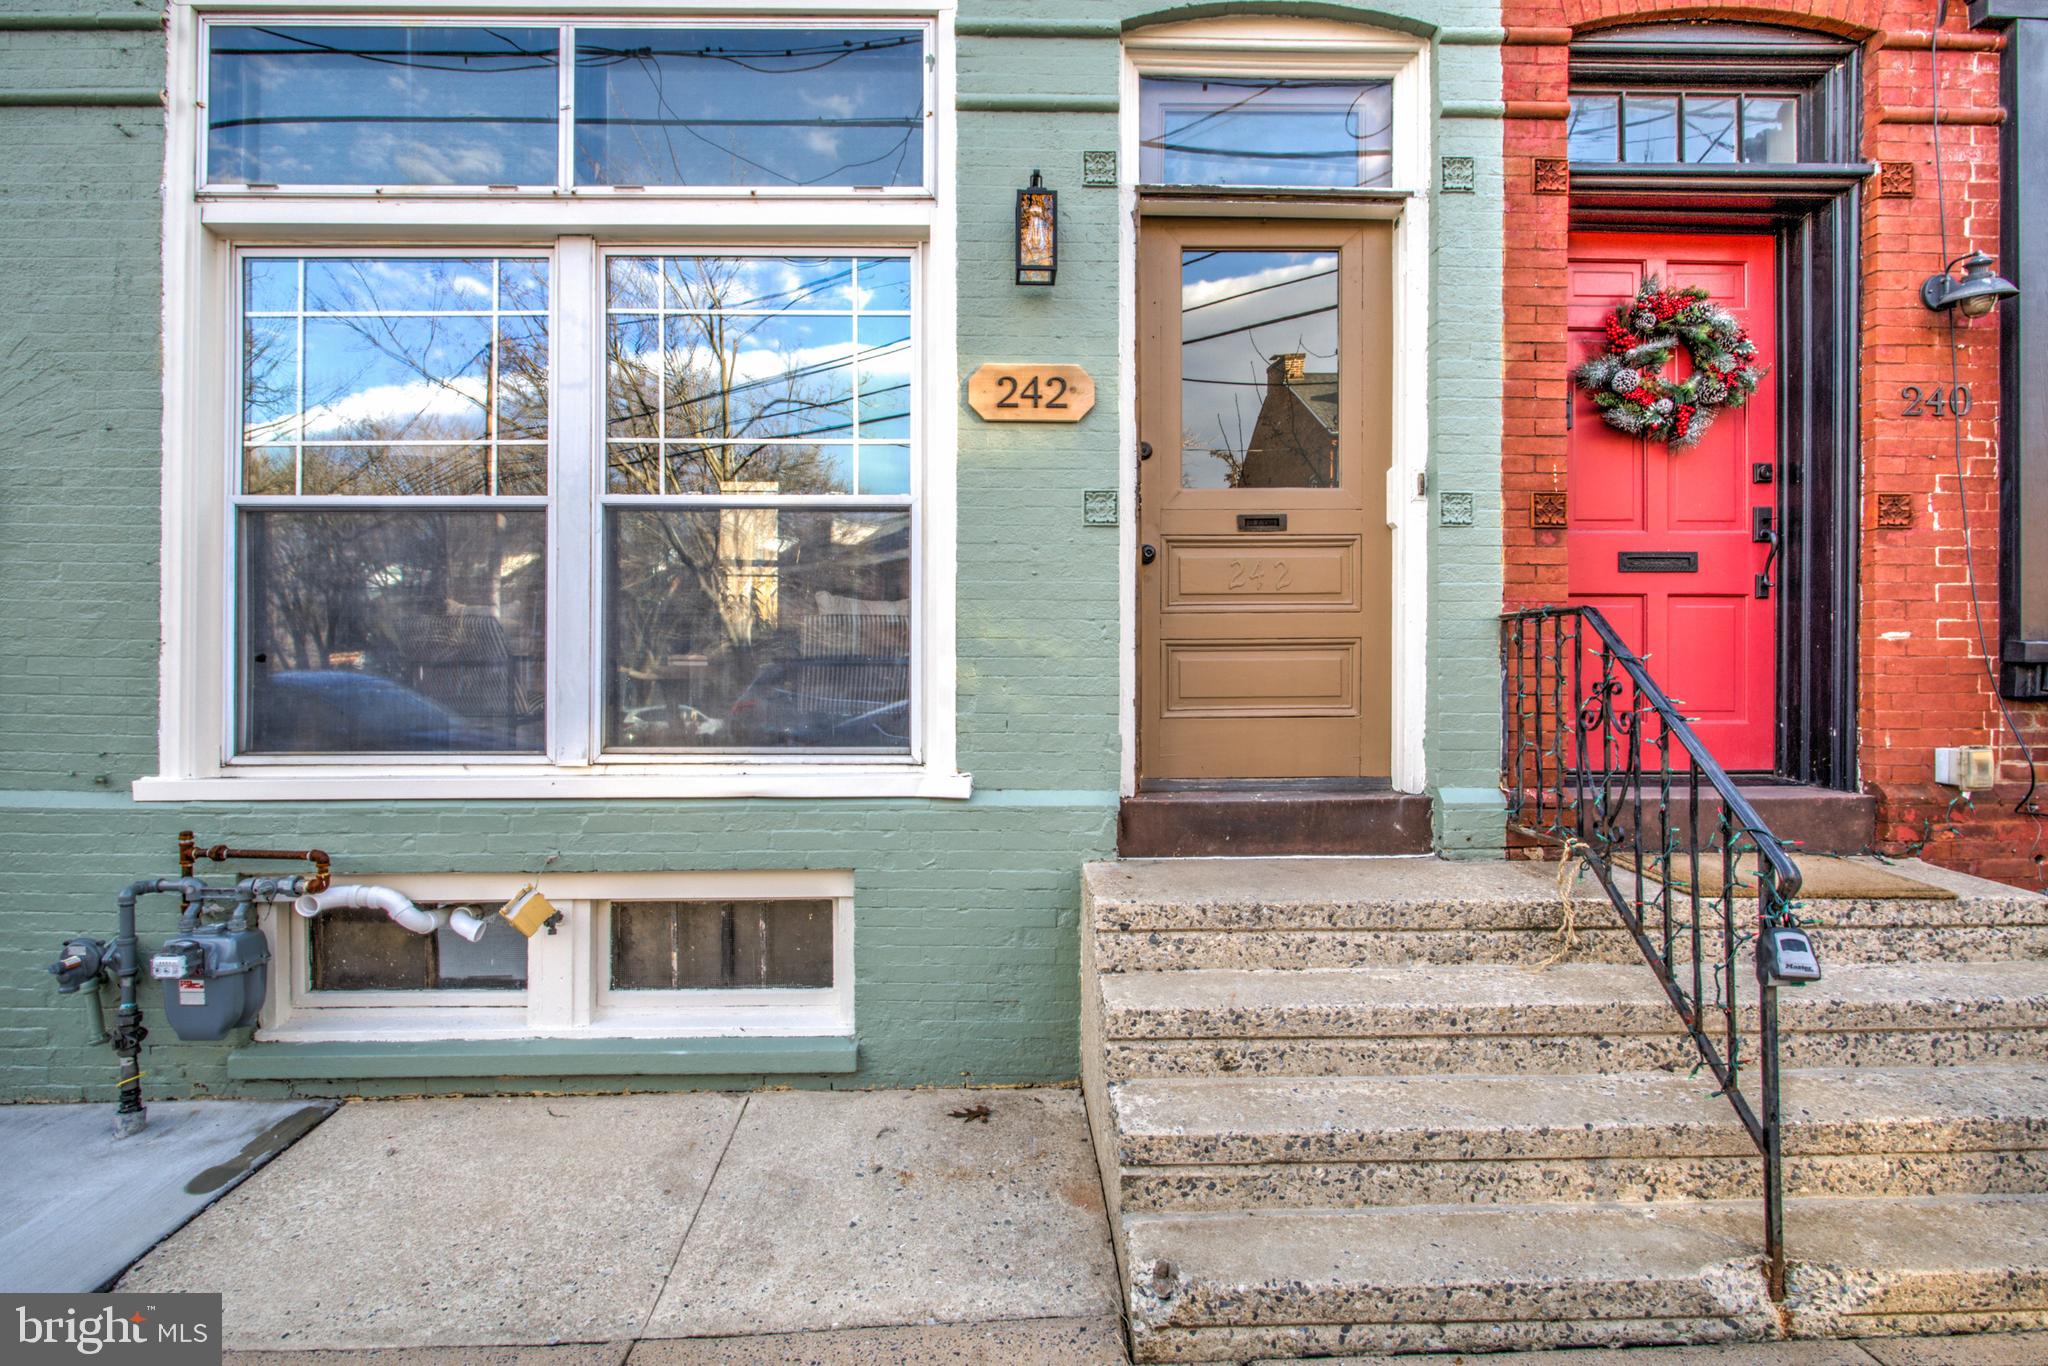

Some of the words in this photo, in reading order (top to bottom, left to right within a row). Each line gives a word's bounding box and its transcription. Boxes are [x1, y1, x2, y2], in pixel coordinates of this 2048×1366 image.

[995, 375, 1068, 409] 242
[1901, 383, 1972, 417] 240
[1228, 559, 1294, 591] 242
